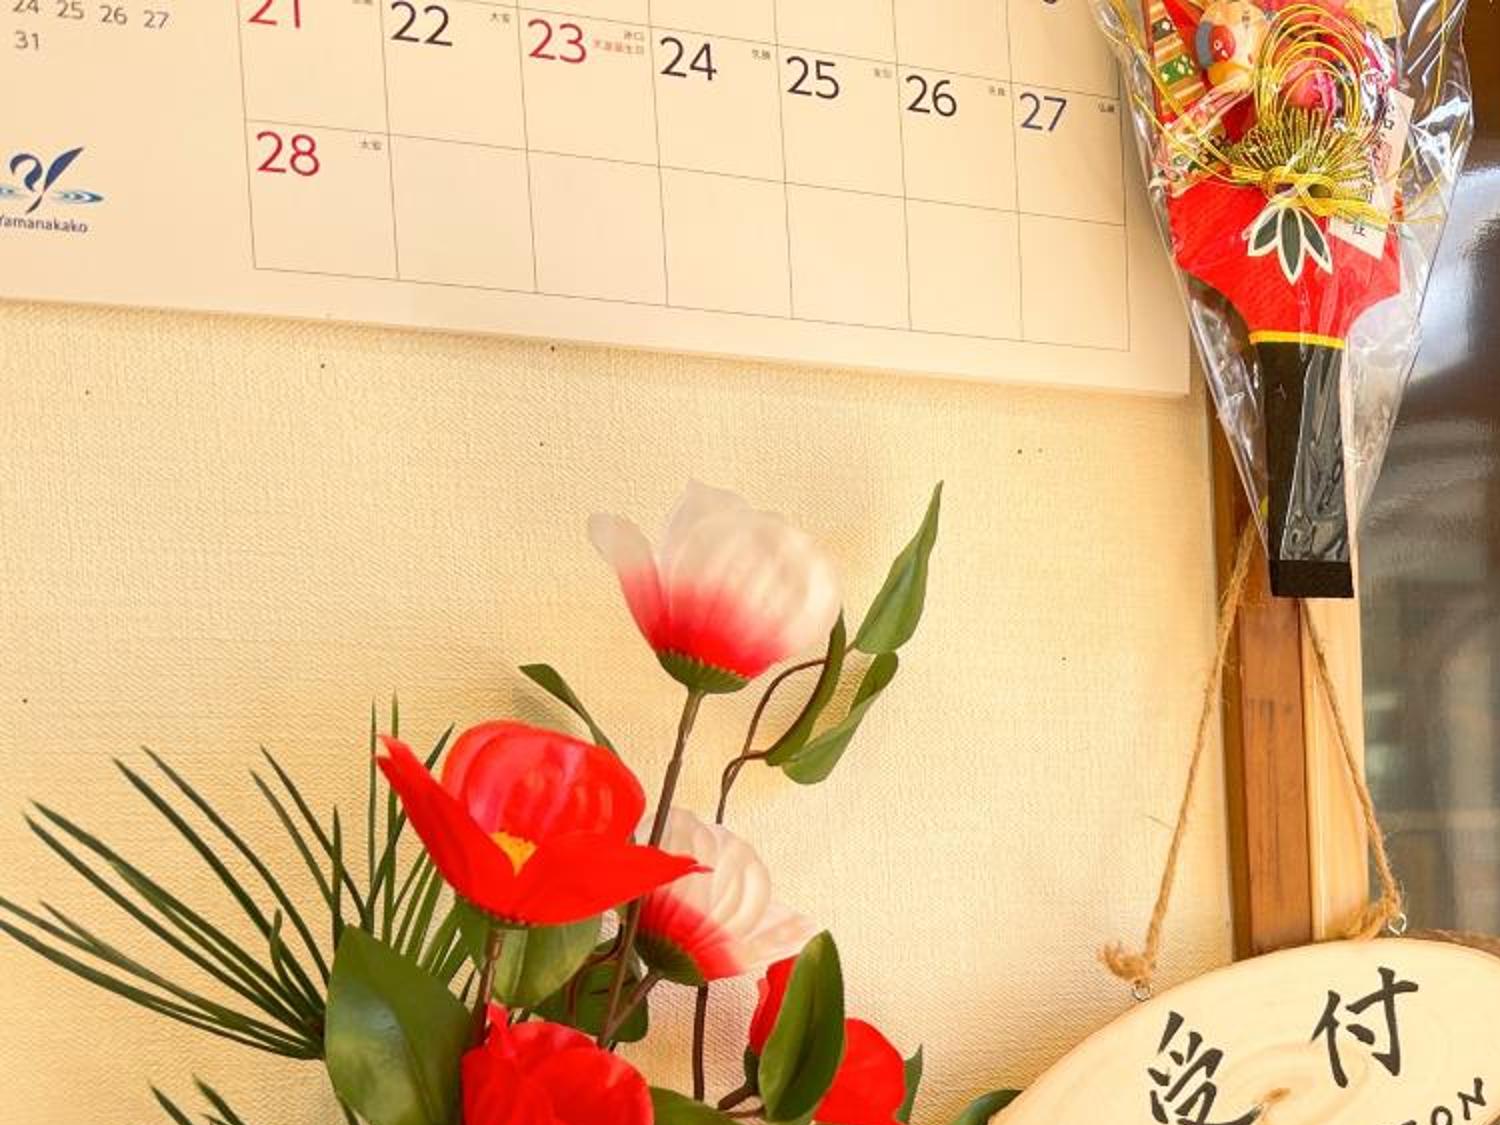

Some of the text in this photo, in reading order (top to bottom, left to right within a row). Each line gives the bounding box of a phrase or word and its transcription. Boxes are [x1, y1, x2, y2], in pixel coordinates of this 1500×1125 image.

[13, 0, 170, 29] 24 25 26 27
[248, 0, 301, 29] 21
[391, 1, 453, 47] 22
[14, 30, 40, 50] 31
[528, 19, 587, 64] 23
[660, 37, 717, 81] 24
[787, 56, 839, 99] 25
[906, 75, 957, 117] 26
[1020, 92, 1067, 132] 27
[257, 131, 320, 176] 28
